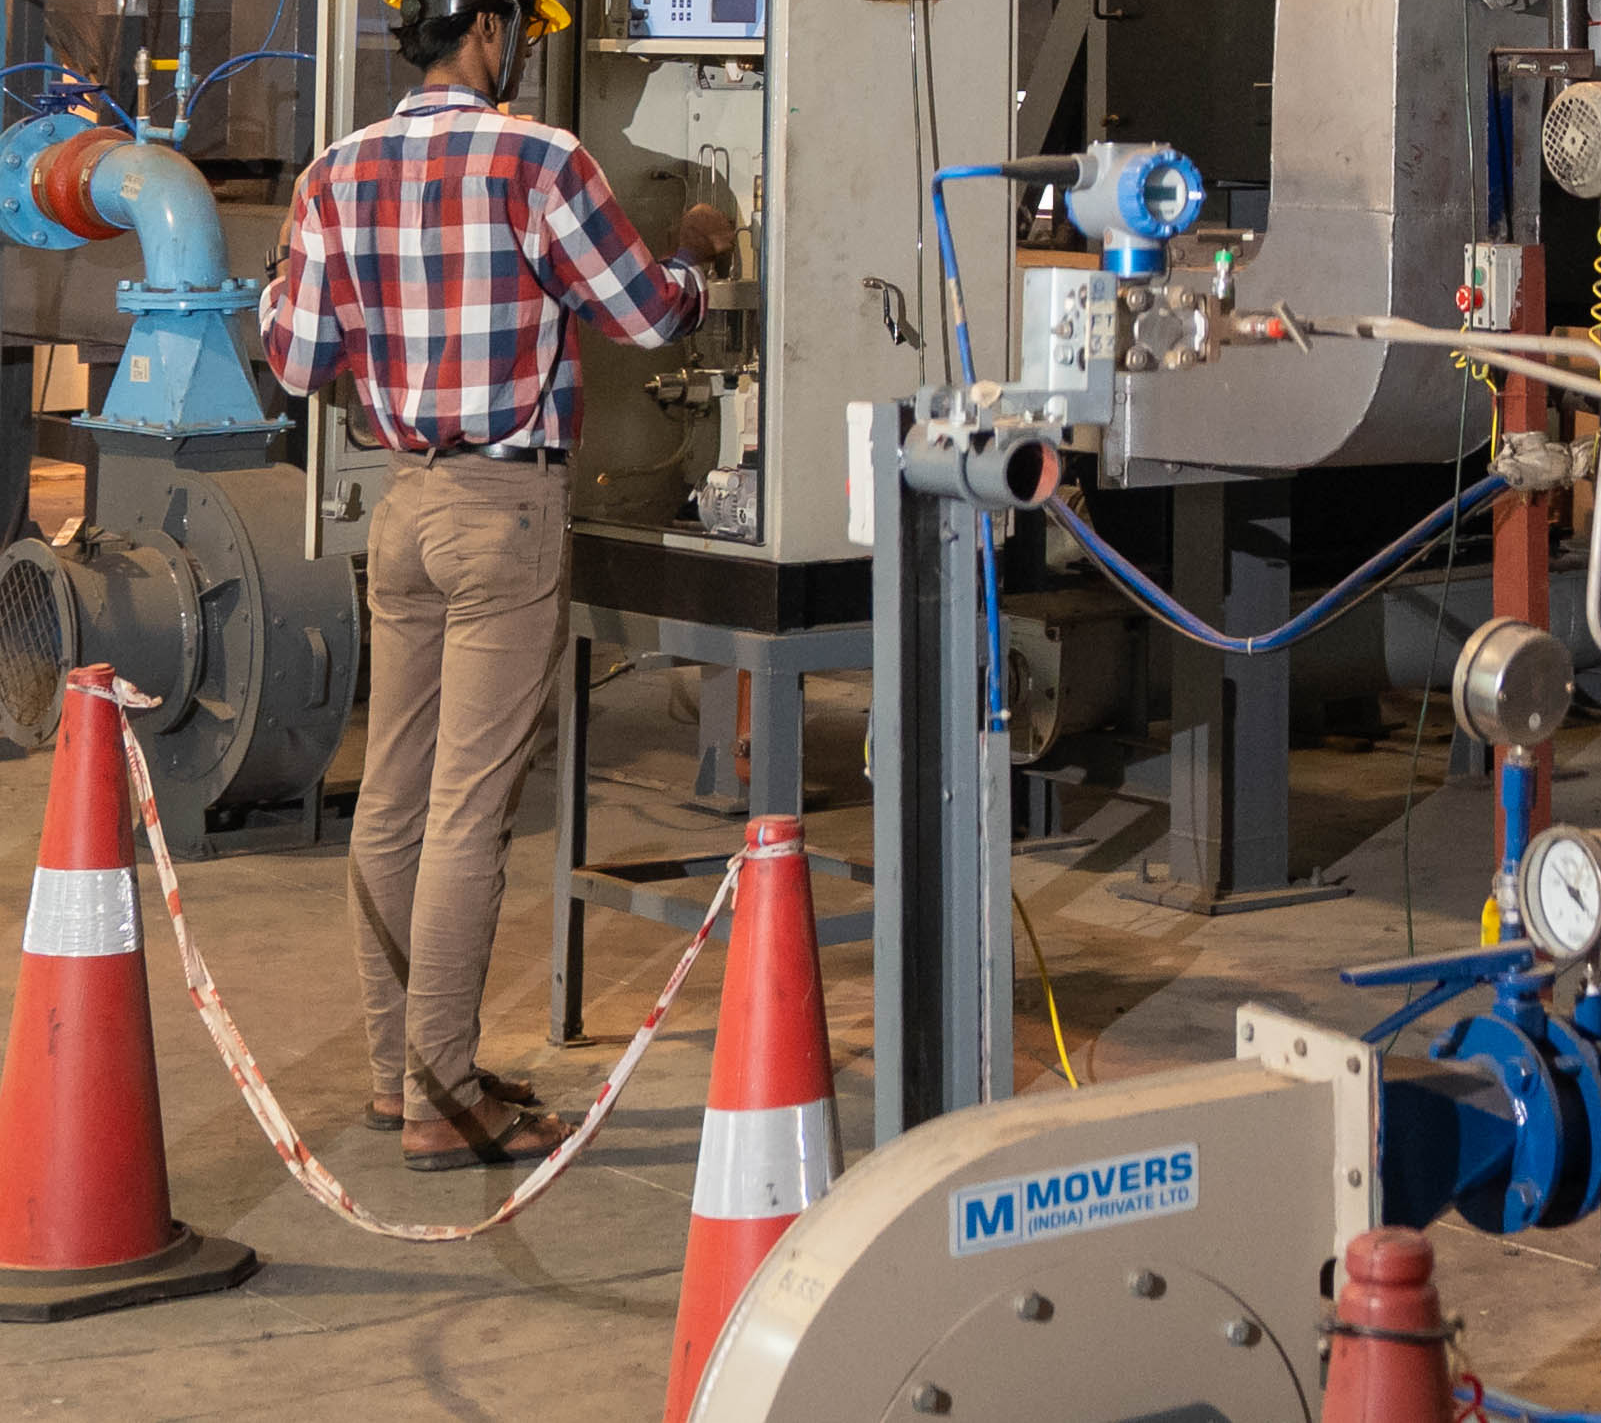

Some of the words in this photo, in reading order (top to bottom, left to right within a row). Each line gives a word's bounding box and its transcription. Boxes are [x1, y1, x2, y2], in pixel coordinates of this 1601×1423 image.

[966, 1193, 1014, 1240] M
[1027, 1152, 1193, 1212] MOVERS
[1028, 1208, 1083, 1236] (INDIA)
[1088, 1193, 1155, 1221] PRIVATE
